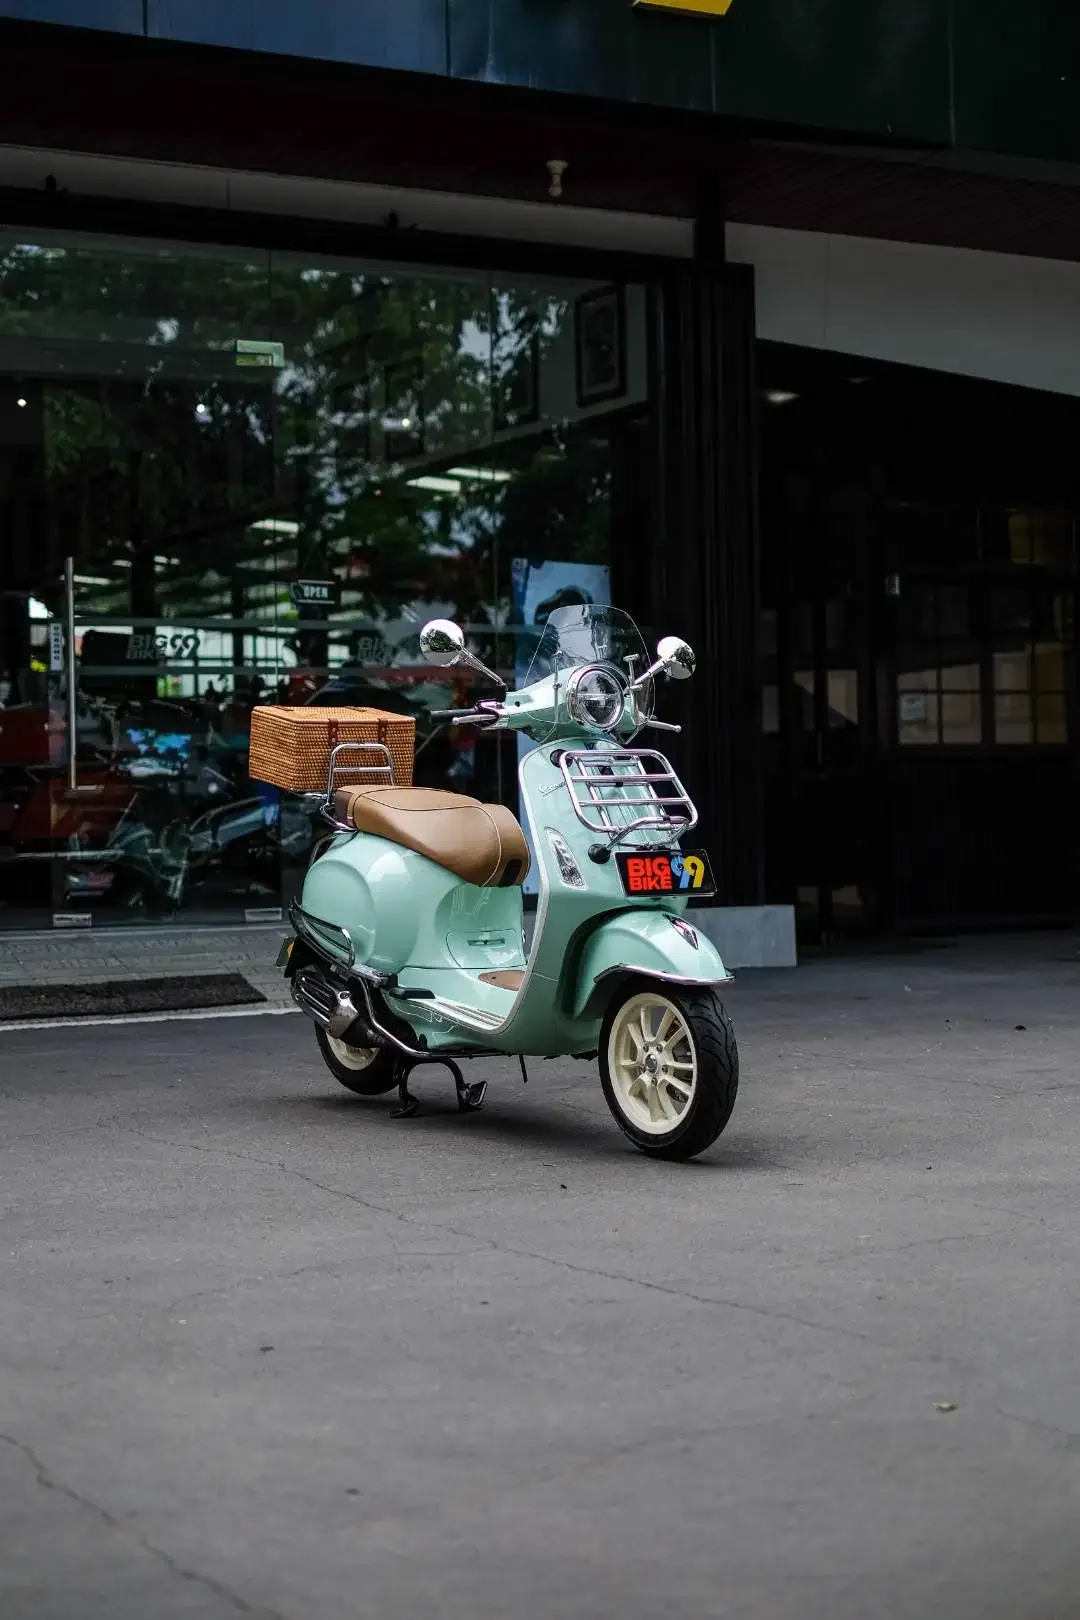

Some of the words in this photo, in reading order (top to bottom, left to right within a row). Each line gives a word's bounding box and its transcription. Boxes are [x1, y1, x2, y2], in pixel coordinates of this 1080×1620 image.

[304, 585, 328, 598] OPEN
[128, 634, 167, 649] BIG
[171, 634, 200, 659] 99
[626, 856, 671, 876] BIG
[670, 855, 705, 889] 99
[628, 875, 673, 891] BIKE
